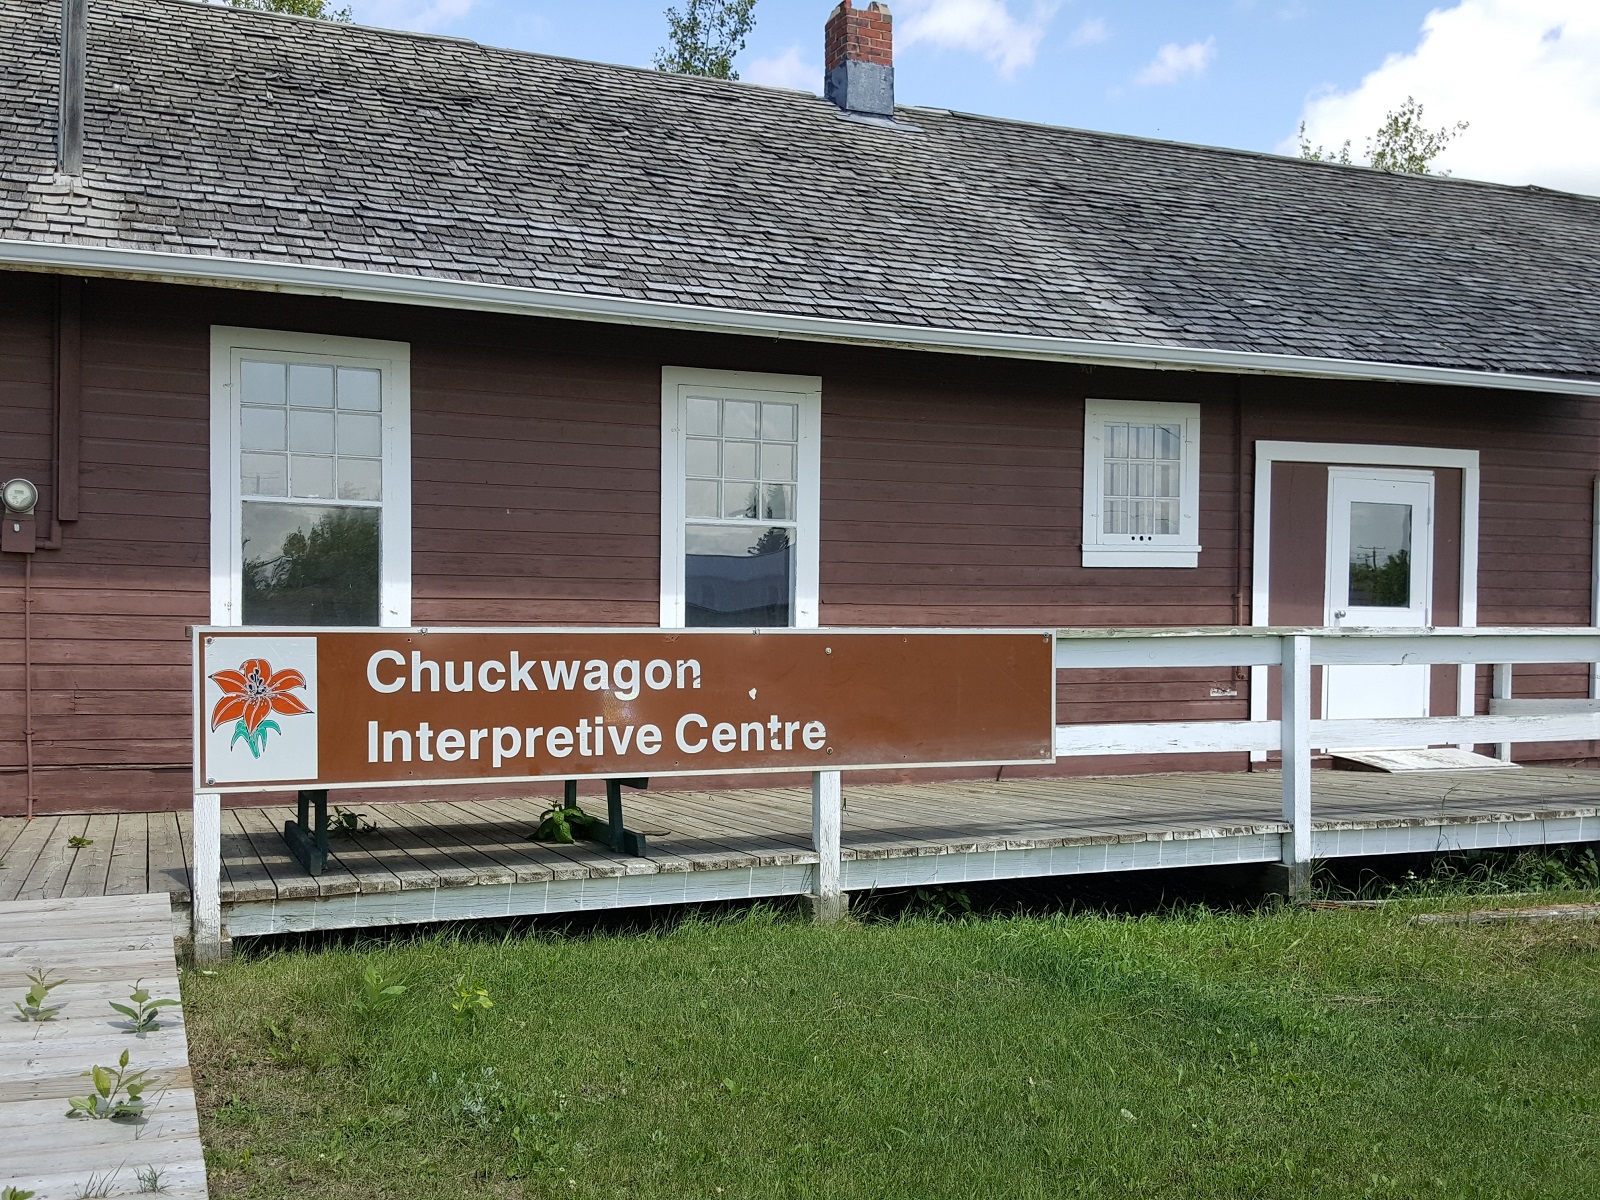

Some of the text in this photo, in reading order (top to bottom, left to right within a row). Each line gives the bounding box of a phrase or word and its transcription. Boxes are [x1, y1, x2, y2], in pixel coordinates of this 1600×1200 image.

[366, 650, 701, 701] Chuckwagon
[368, 713, 827, 768] Interpretive Centre
